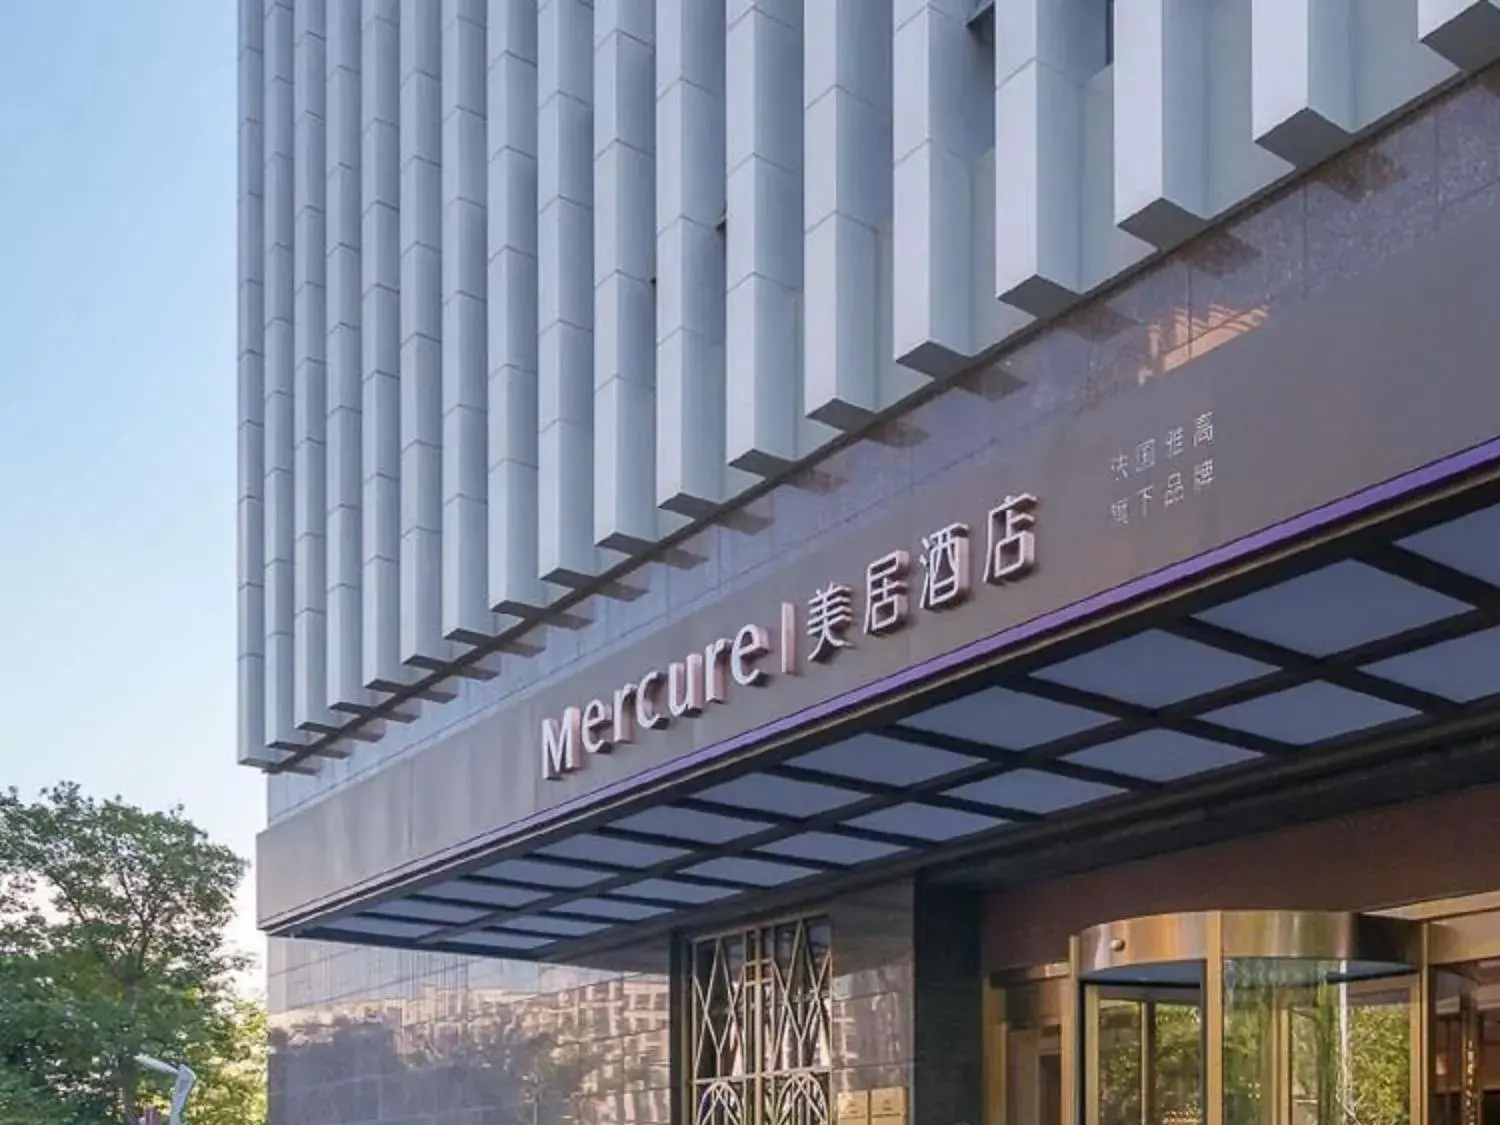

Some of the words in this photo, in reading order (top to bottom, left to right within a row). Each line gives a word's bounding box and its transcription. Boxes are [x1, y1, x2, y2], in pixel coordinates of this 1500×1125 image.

[542, 624, 768, 779] Mercure
[807, 493, 1037, 661] 美居酒店
